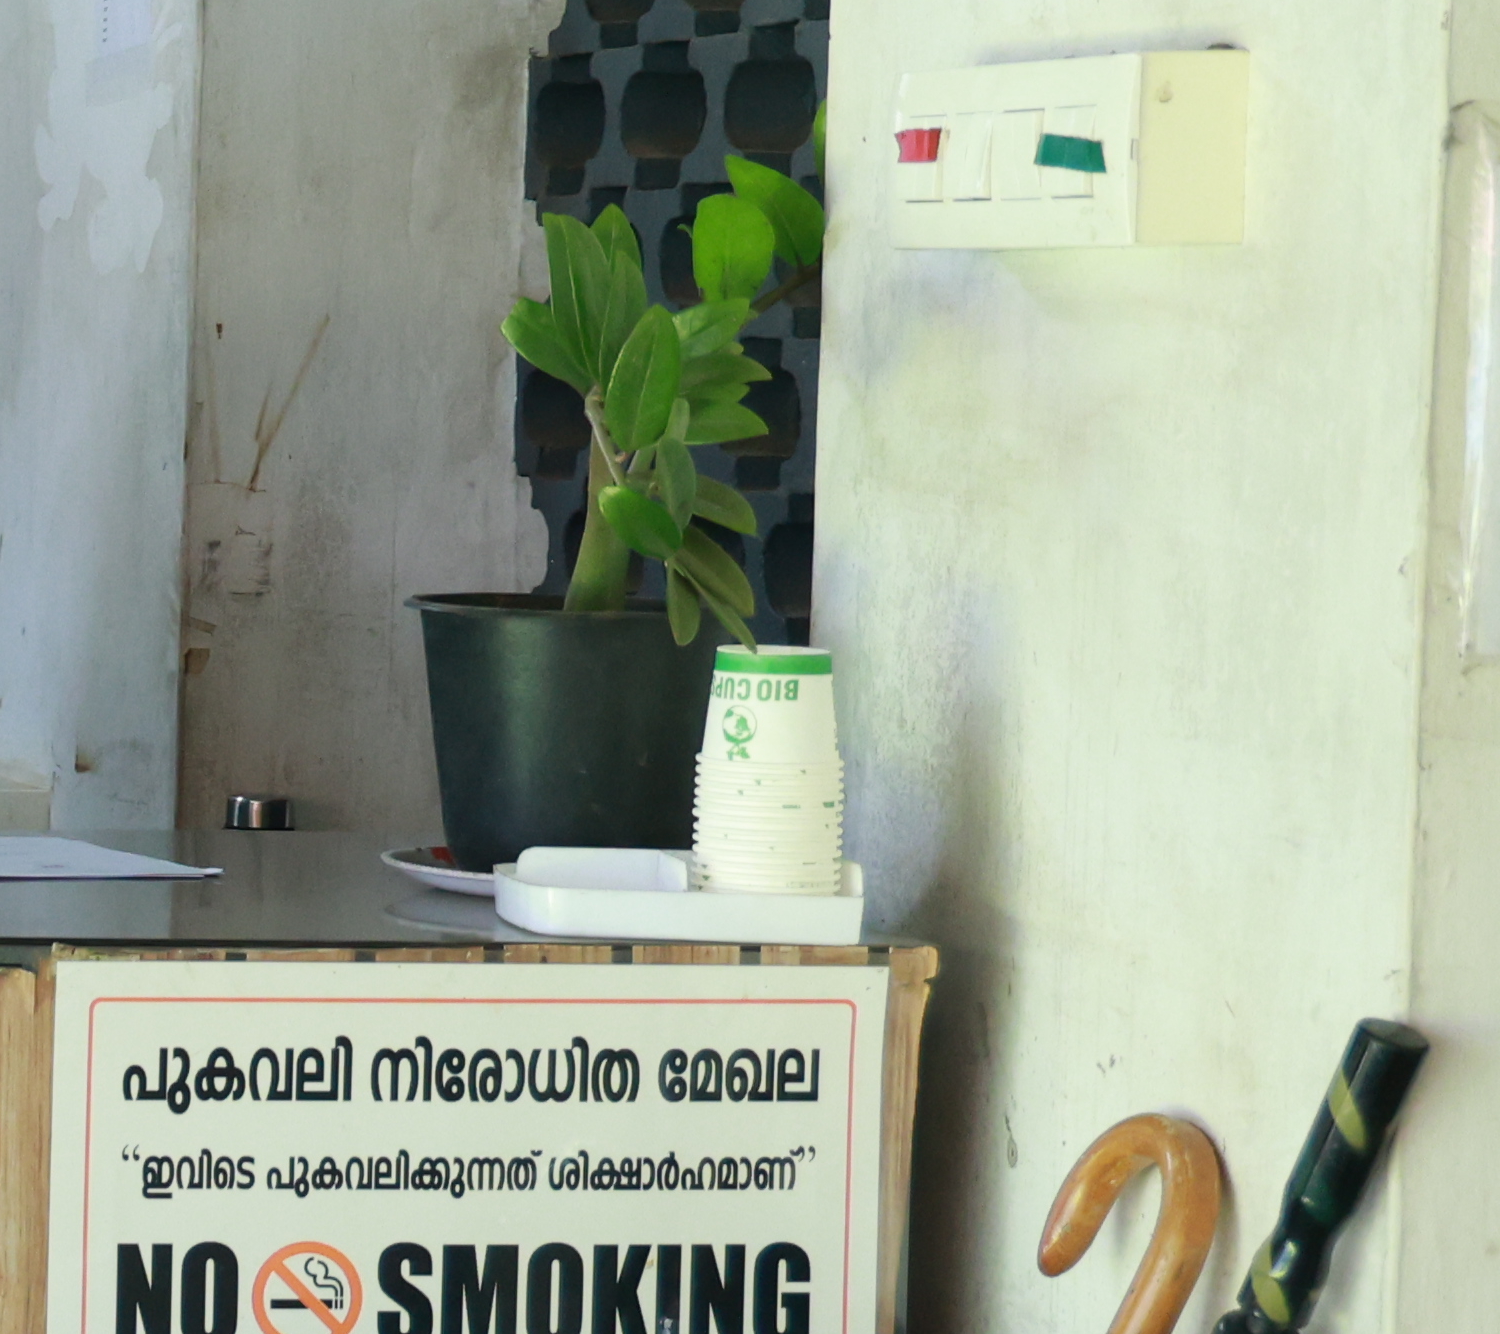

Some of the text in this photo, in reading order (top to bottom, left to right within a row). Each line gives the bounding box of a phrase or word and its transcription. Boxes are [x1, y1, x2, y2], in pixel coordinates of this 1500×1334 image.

[757, 678, 800, 702] BIO
[122, 1035, 821, 1115] പുകവലി നിരോധിത മേഖല
[266, 1148, 543, 1199] പുകവലിക്കുന്നത്
